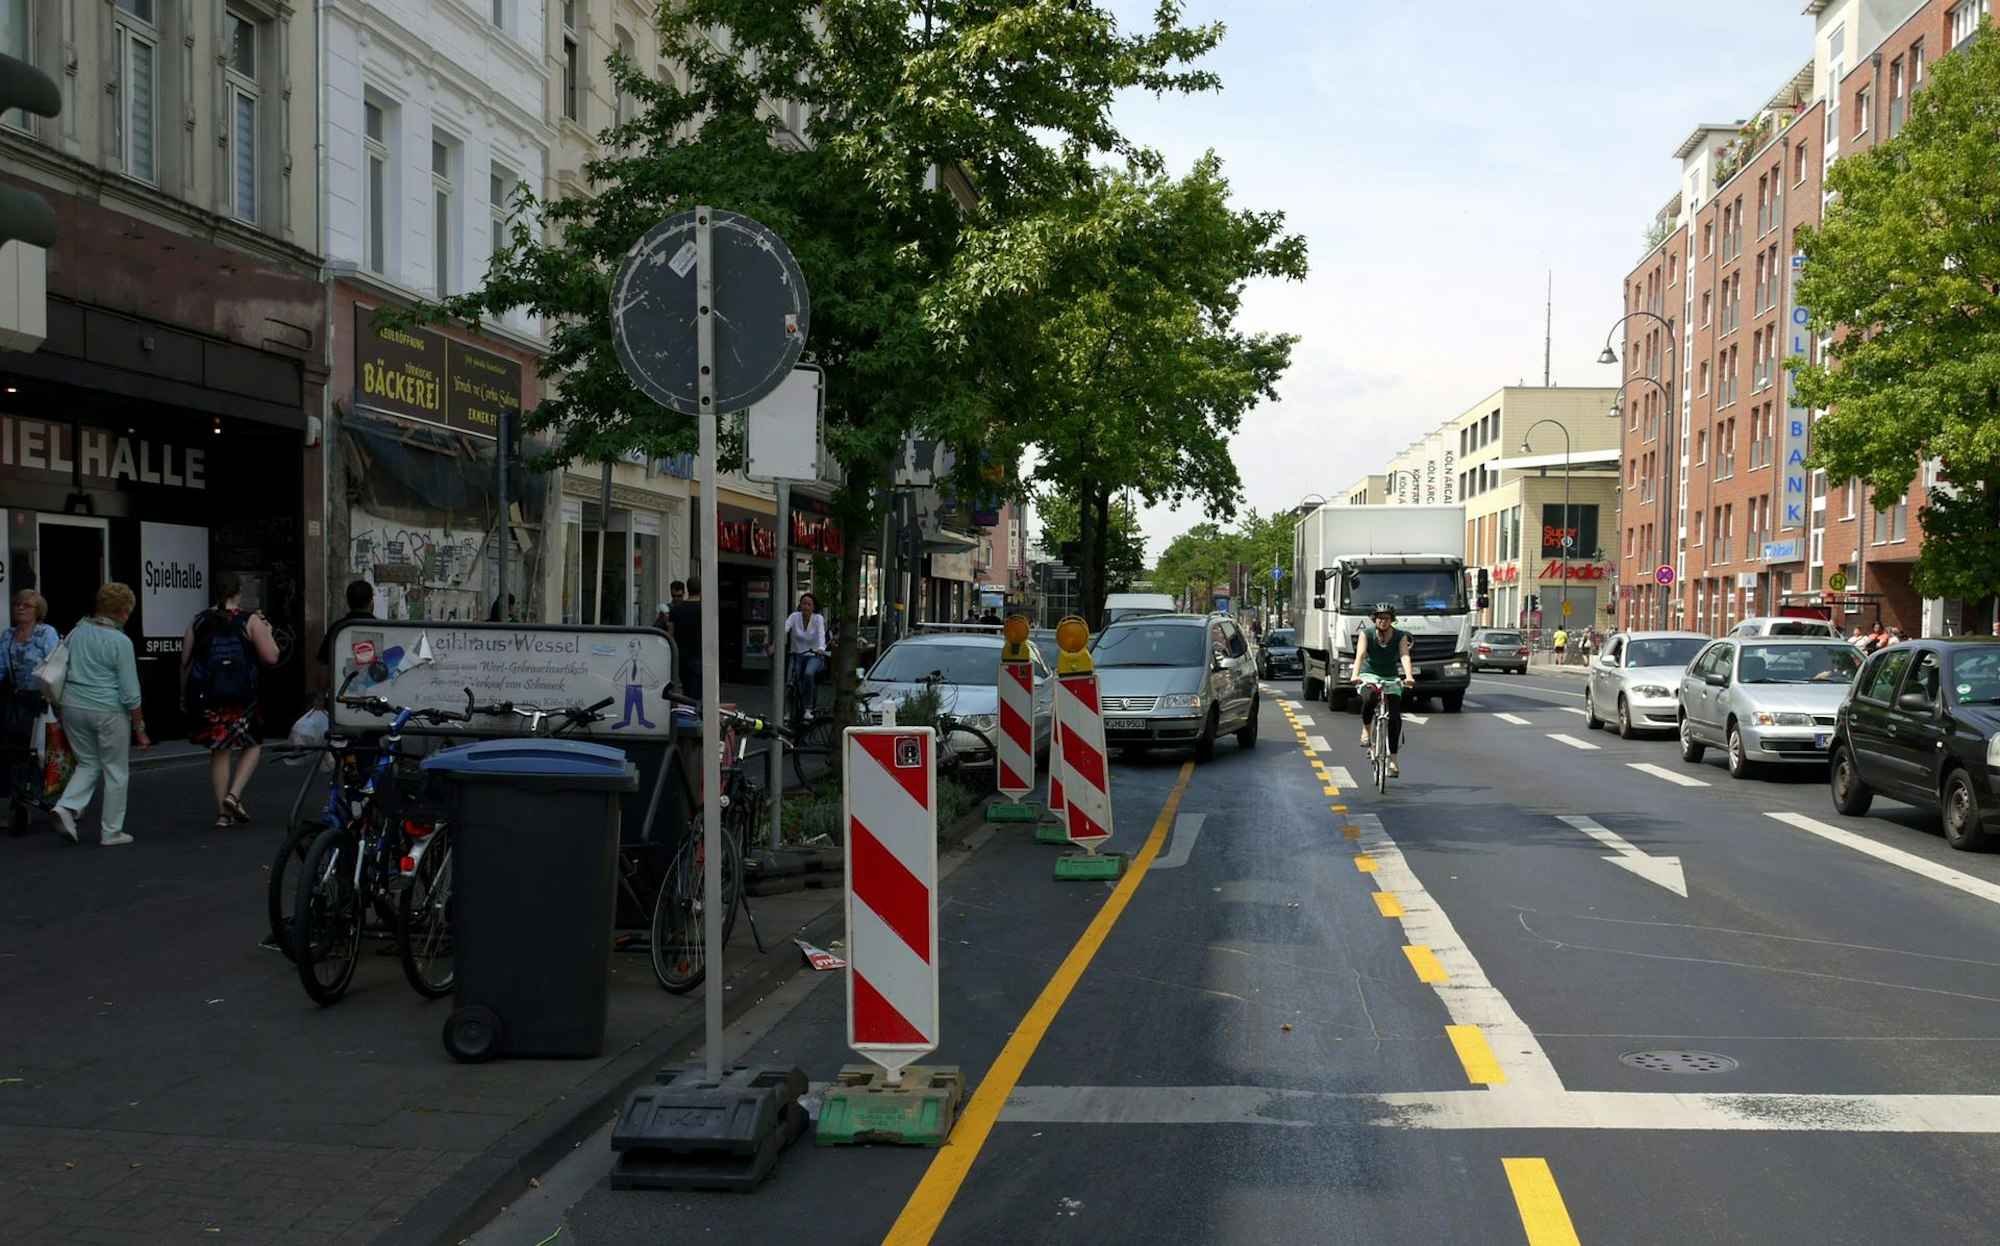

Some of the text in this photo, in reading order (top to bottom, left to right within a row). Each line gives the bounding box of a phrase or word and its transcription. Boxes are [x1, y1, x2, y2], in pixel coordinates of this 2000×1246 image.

[146, 560, 202, 595] Spielhalle
[1538, 560, 1604, 580] Media
[514, 633, 580, 654] Wessel
[524, 677, 566, 693] Schmuck
